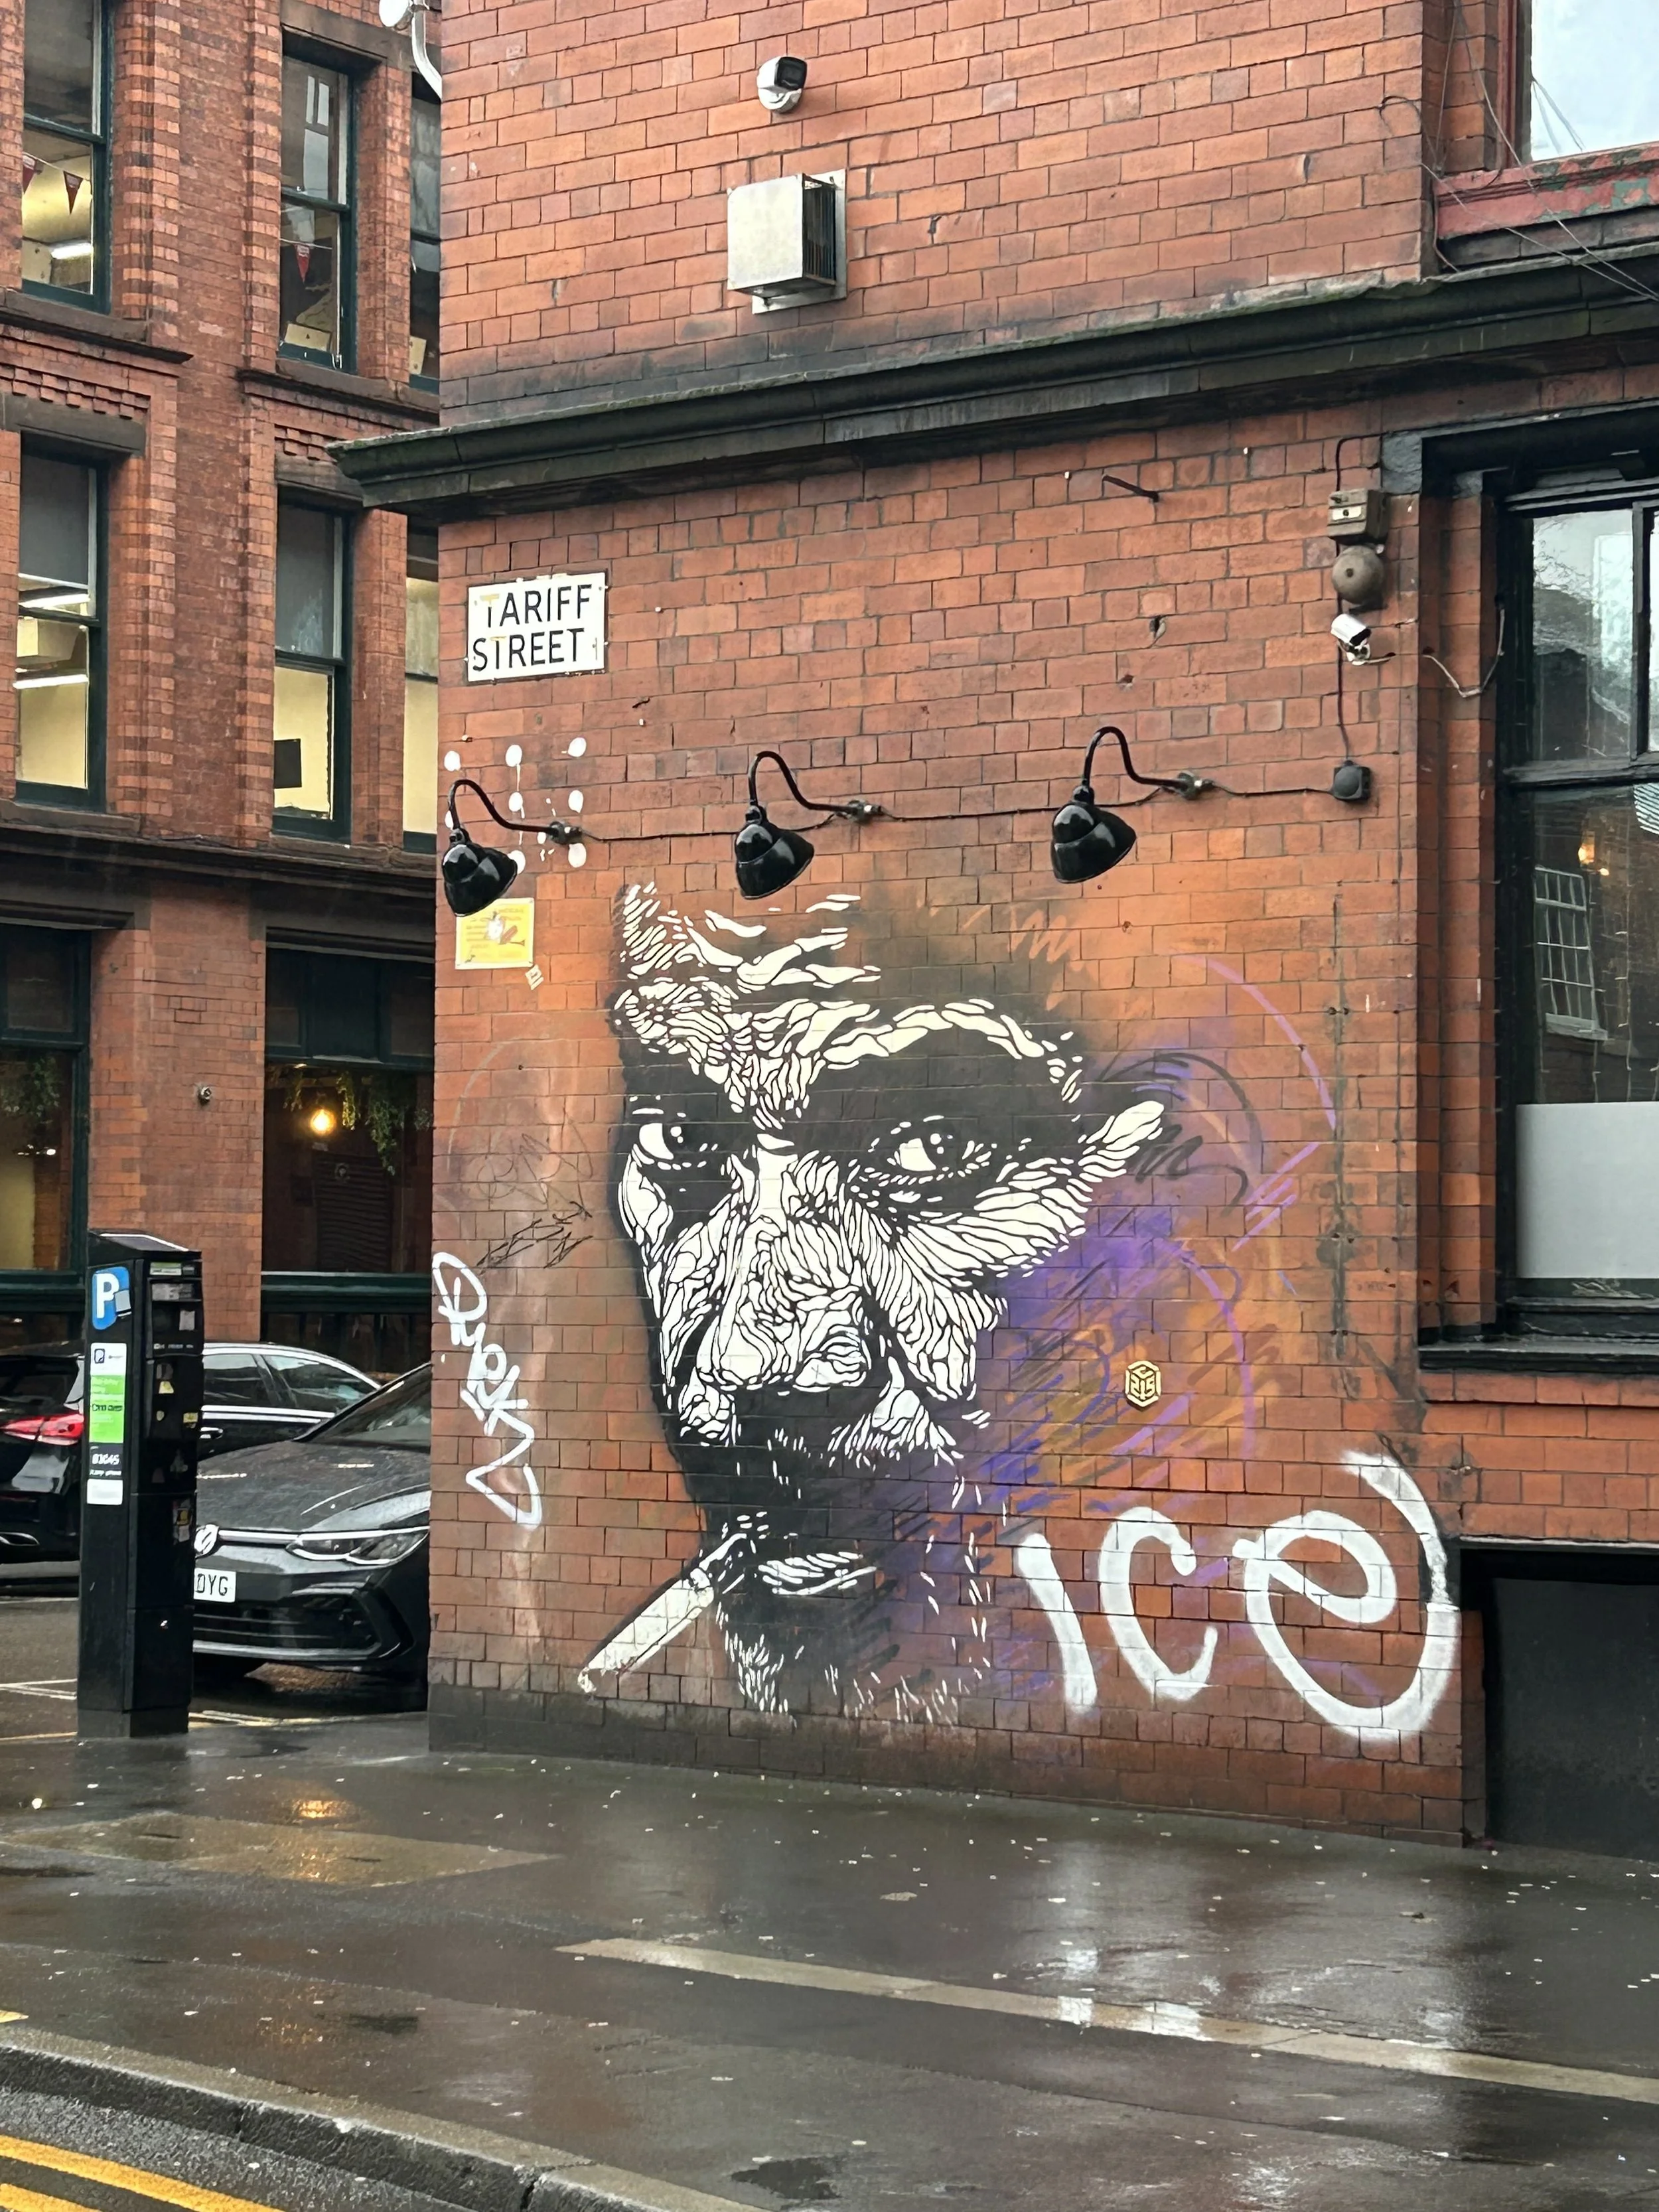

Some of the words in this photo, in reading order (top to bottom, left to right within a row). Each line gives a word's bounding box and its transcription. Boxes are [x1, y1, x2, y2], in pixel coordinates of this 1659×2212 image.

[480, 584, 592, 628] TARIFF
[472, 627, 585, 672] STREET
[96, 1272, 119, 1319] P
